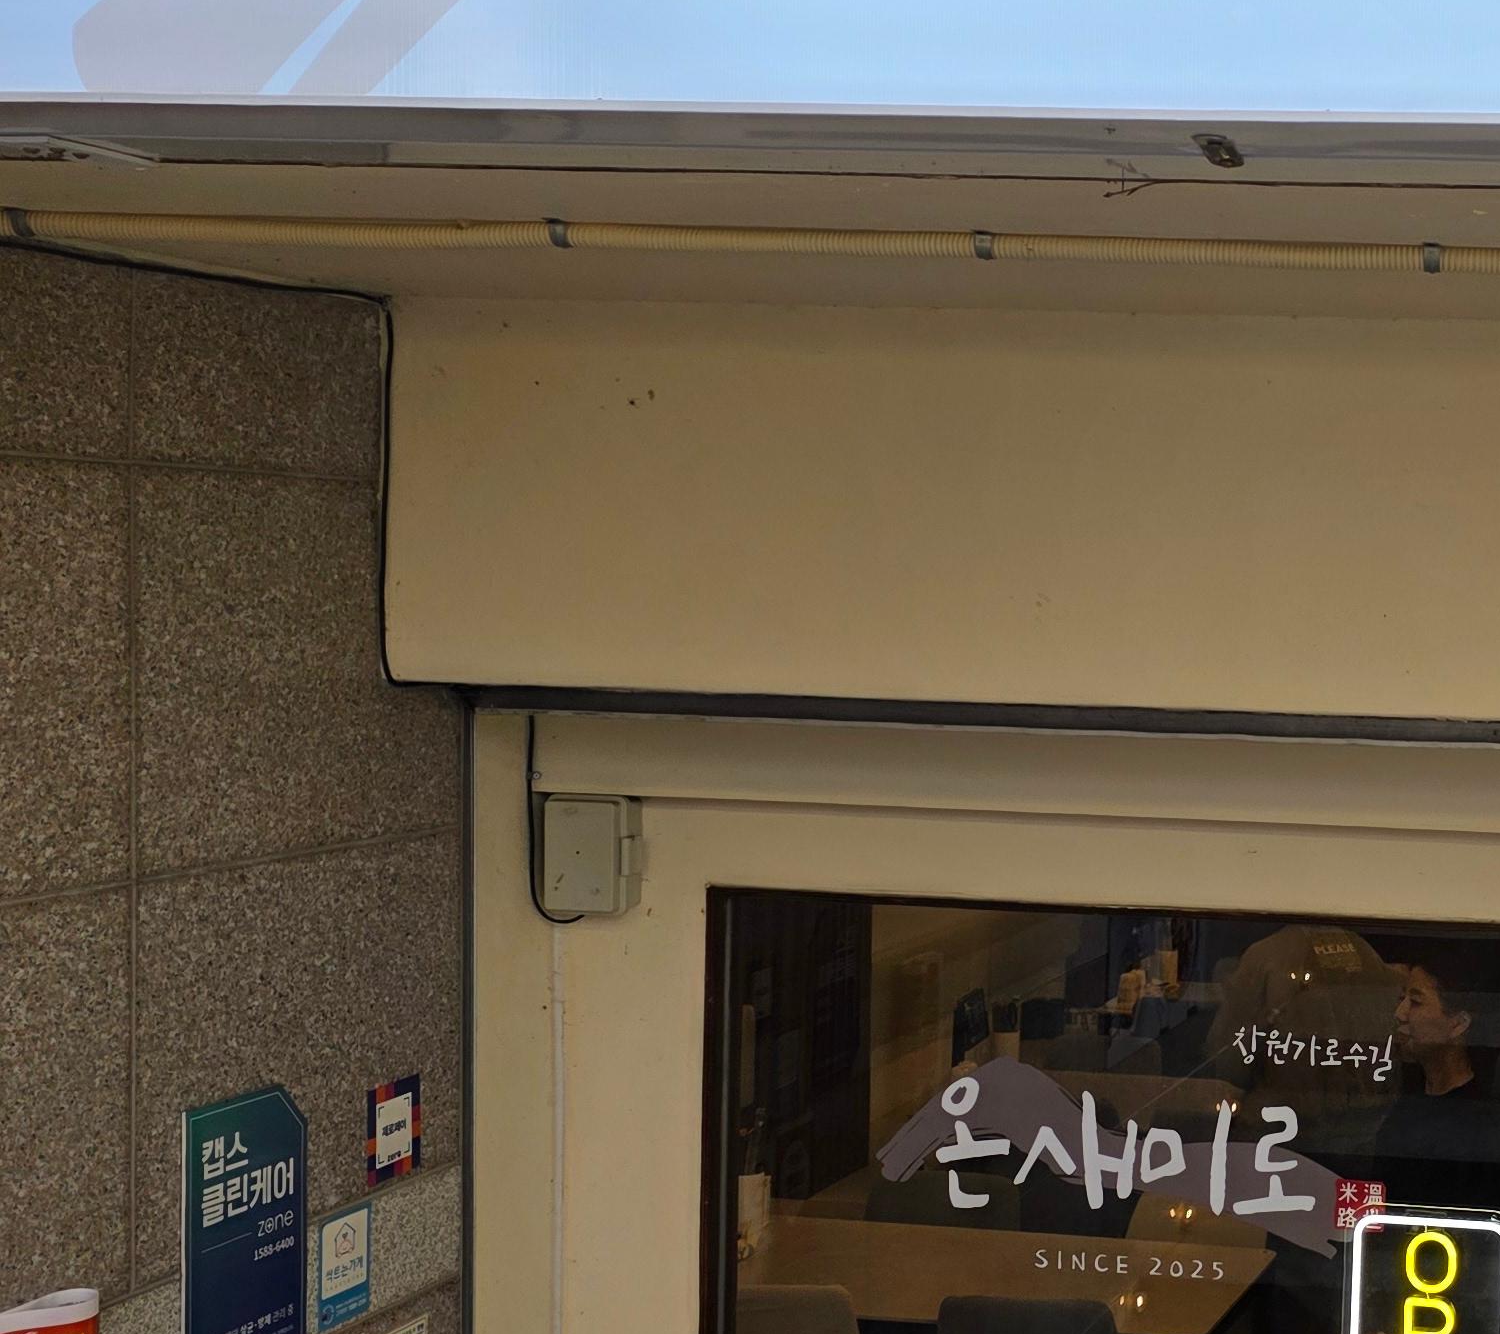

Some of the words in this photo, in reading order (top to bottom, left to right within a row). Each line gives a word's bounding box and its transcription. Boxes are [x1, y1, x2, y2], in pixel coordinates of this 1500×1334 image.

[1313, 943, 1356, 955] PLEASE
[1232, 1024, 1393, 1082] 창원가로수길
[201, 1131, 249, 1180] 캡스
[936, 1076, 1316, 1216] 온새미로
[201, 1157, 294, 1228] 클린케어
[257, 1210, 293, 1237] zone
[1035, 1249, 1129, 1274] SINCE
[1149, 1257, 1225, 1281] 2025
